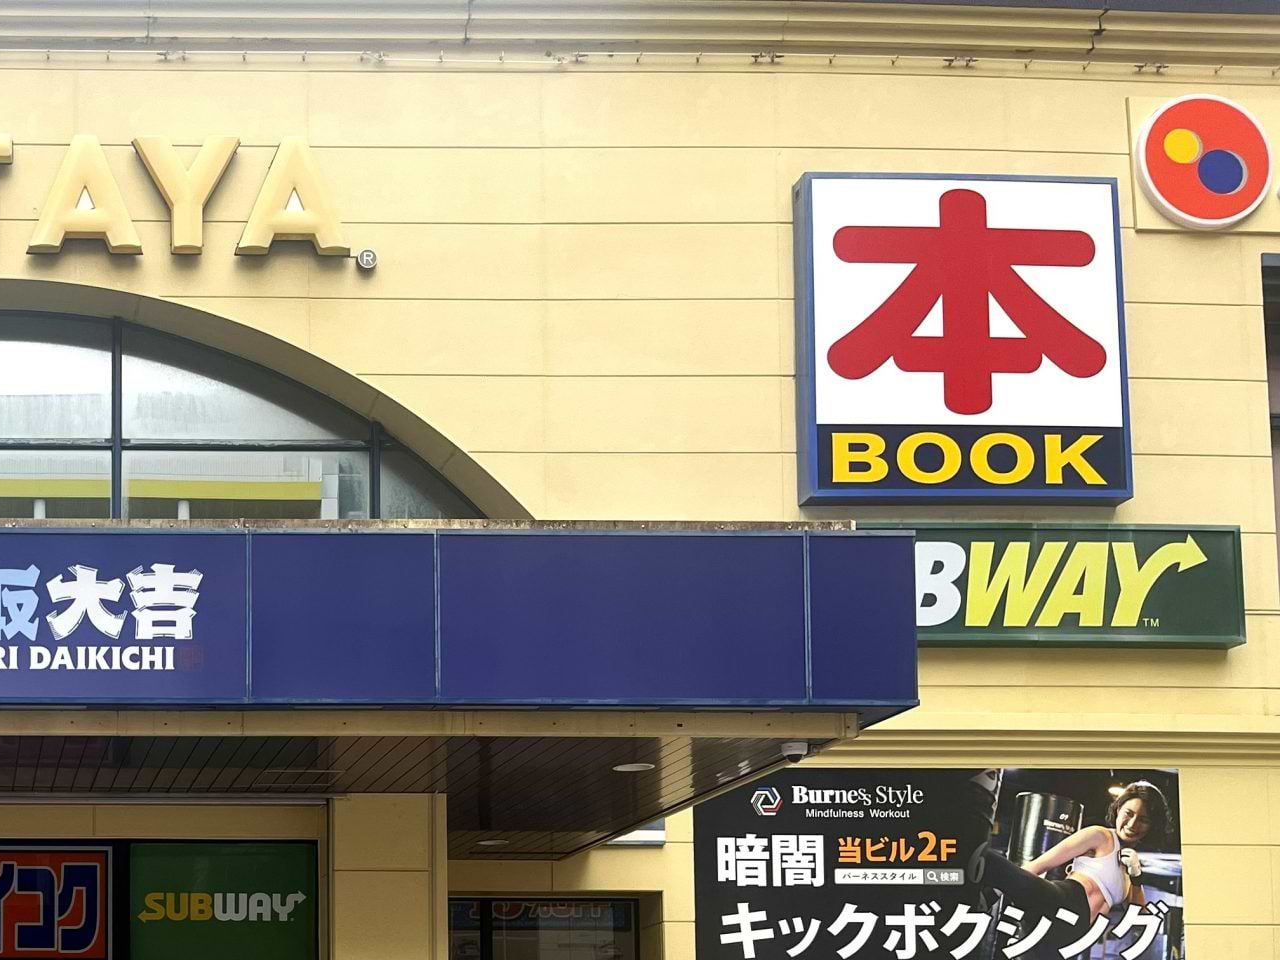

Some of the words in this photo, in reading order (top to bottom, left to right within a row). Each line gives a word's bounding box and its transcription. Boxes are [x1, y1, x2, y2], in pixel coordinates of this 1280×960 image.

[826, 188, 1108, 416] 本
[830, 431, 1109, 485] BOOK
[29, 644, 175, 671] DAIKICHI
[792, 784, 872, 806] Burness
[875, 784, 924, 808] Style
[805, 808, 864, 818] Mindfulness
[870, 808, 910, 818] Workout
[716, 832, 825, 888] 暗闇
[837, 830, 957, 864] 当ビル2F
[137, 890, 307, 923] SUBWAY
